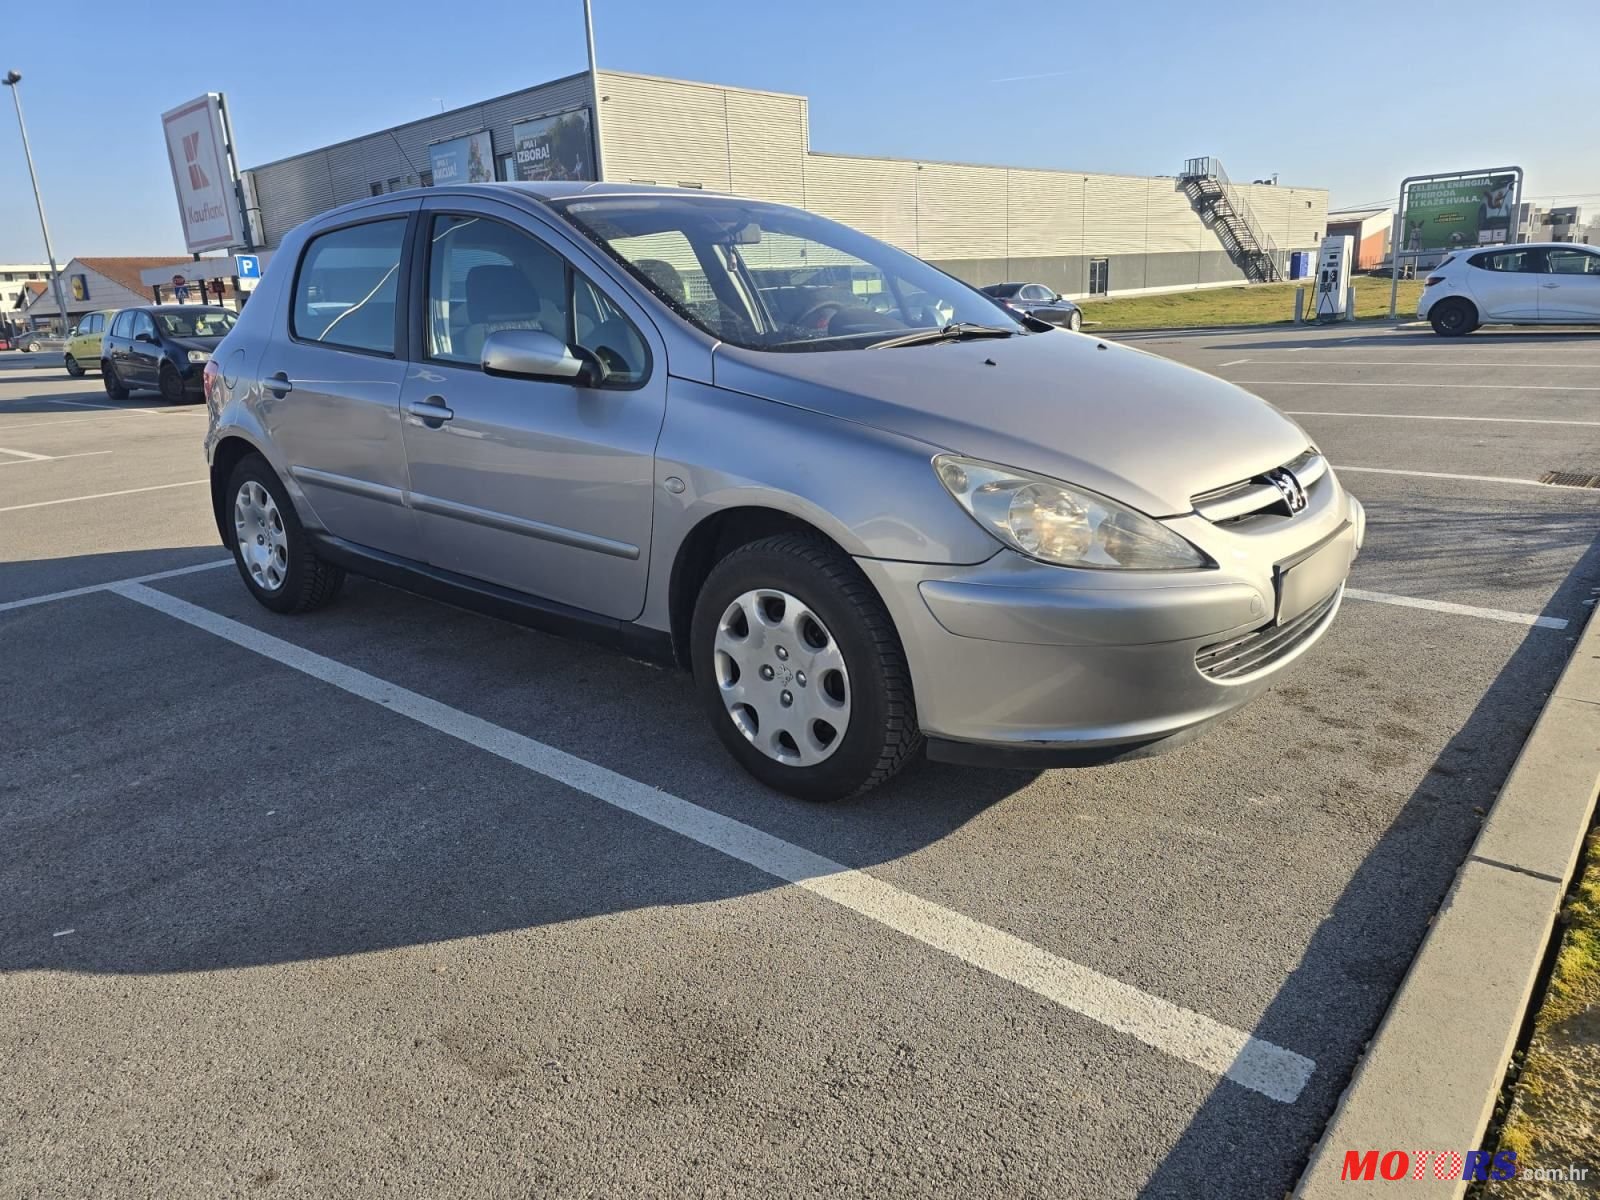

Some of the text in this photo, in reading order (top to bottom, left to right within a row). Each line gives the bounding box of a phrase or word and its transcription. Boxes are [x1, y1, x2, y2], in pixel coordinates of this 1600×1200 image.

[517, 144, 550, 163] IZBORA!
[1410, 183, 1445, 192] ZELENA
[1415, 190, 1456, 200] PRIRODA
[1409, 200, 1418, 208] TI
[188, 202, 225, 224] Kaufland
[242, 260, 253, 274] P
